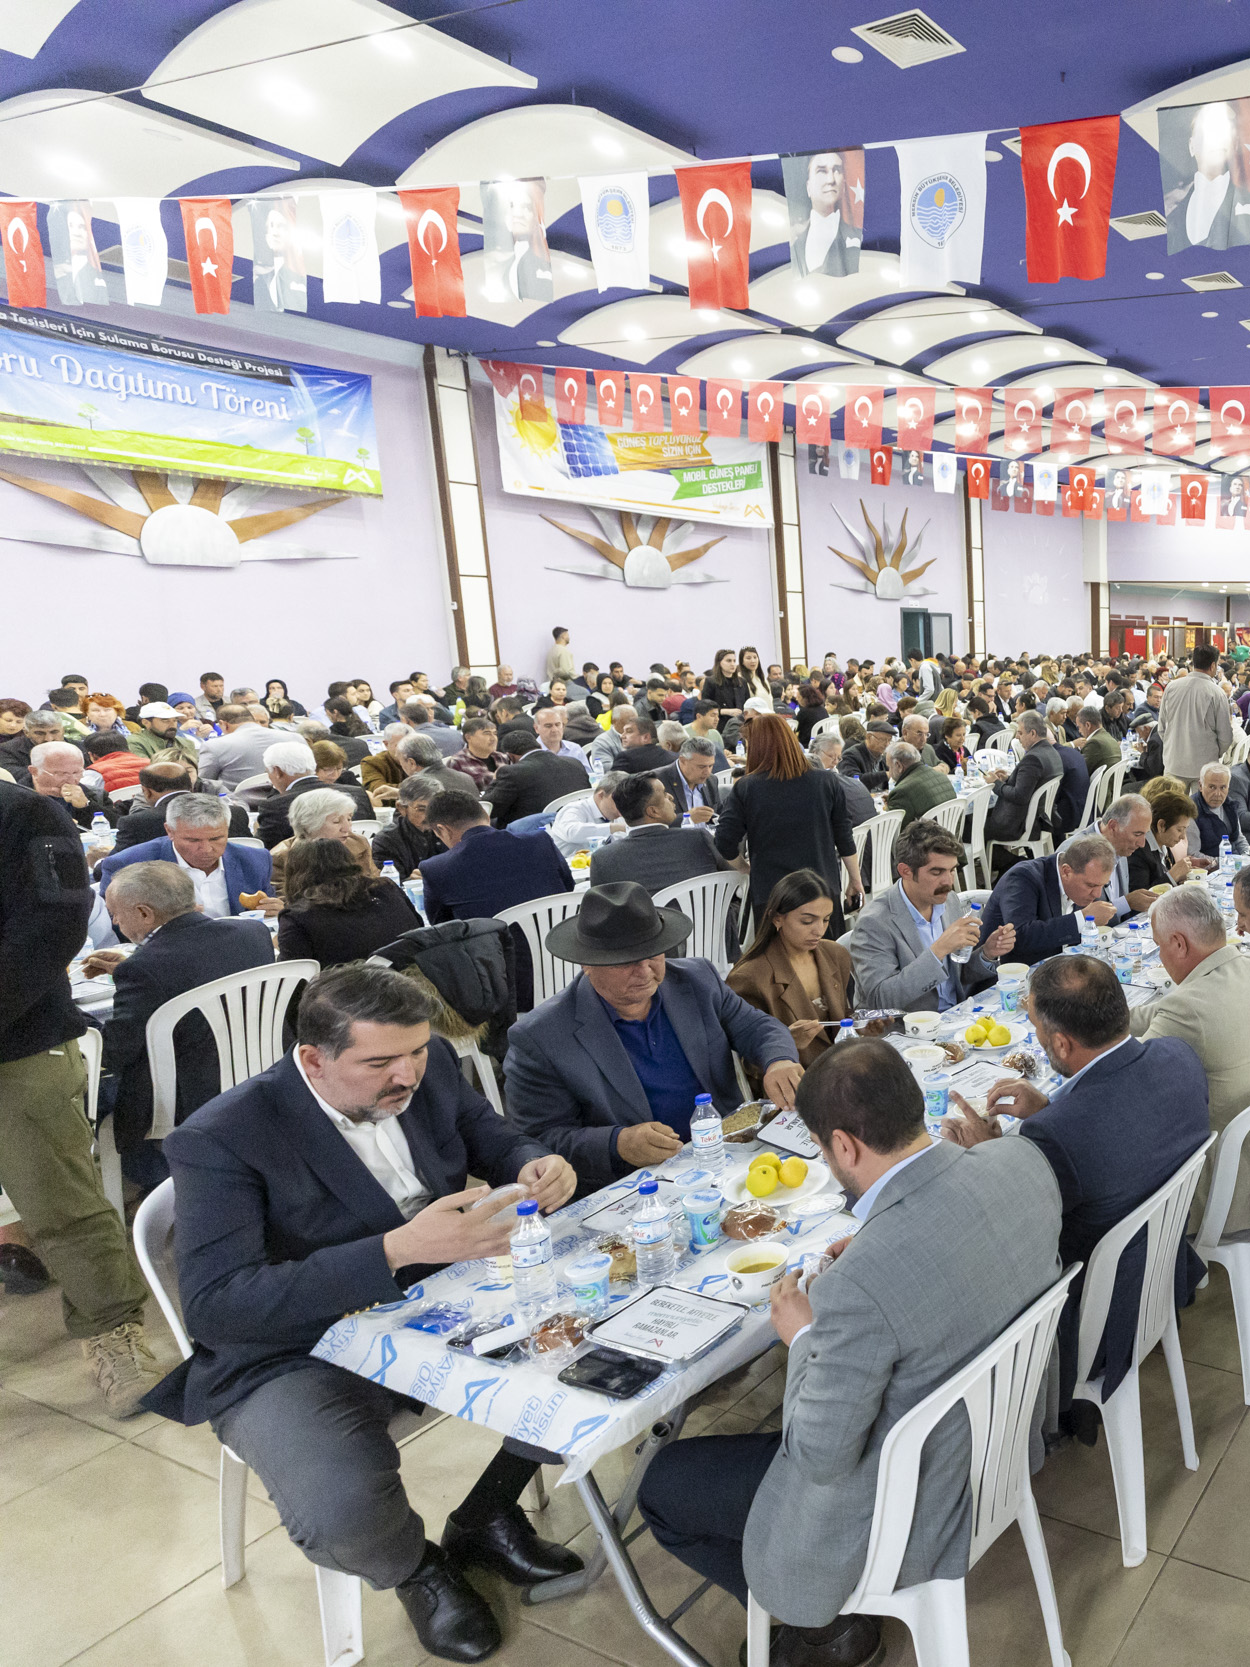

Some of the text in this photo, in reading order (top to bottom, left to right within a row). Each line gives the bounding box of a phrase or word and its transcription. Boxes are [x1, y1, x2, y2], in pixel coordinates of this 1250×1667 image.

[10, 311, 68, 333] Tesisleri
[70, 322, 96, 339] İçin
[98, 332, 149, 350] Sulama
[151, 343, 195, 360] Borusu
[197, 352, 243, 370] Desteği
[244, 362, 283, 377] Projesi
[50, 353, 198, 405] Dağıtımı
[200, 382, 292, 421] Töreni
[617, 435, 646, 450] GÜNEŞ
[662, 443, 702, 458] SİZİN İÇİN
[683, 469, 707, 483] MOBİL
[709, 466, 734, 480] GÜNEŞ
[702, 477, 746, 495] DESTEKLERİ
[320, 1319, 357, 1361] Afiye
[425, 1353, 455, 1403] Afiye
